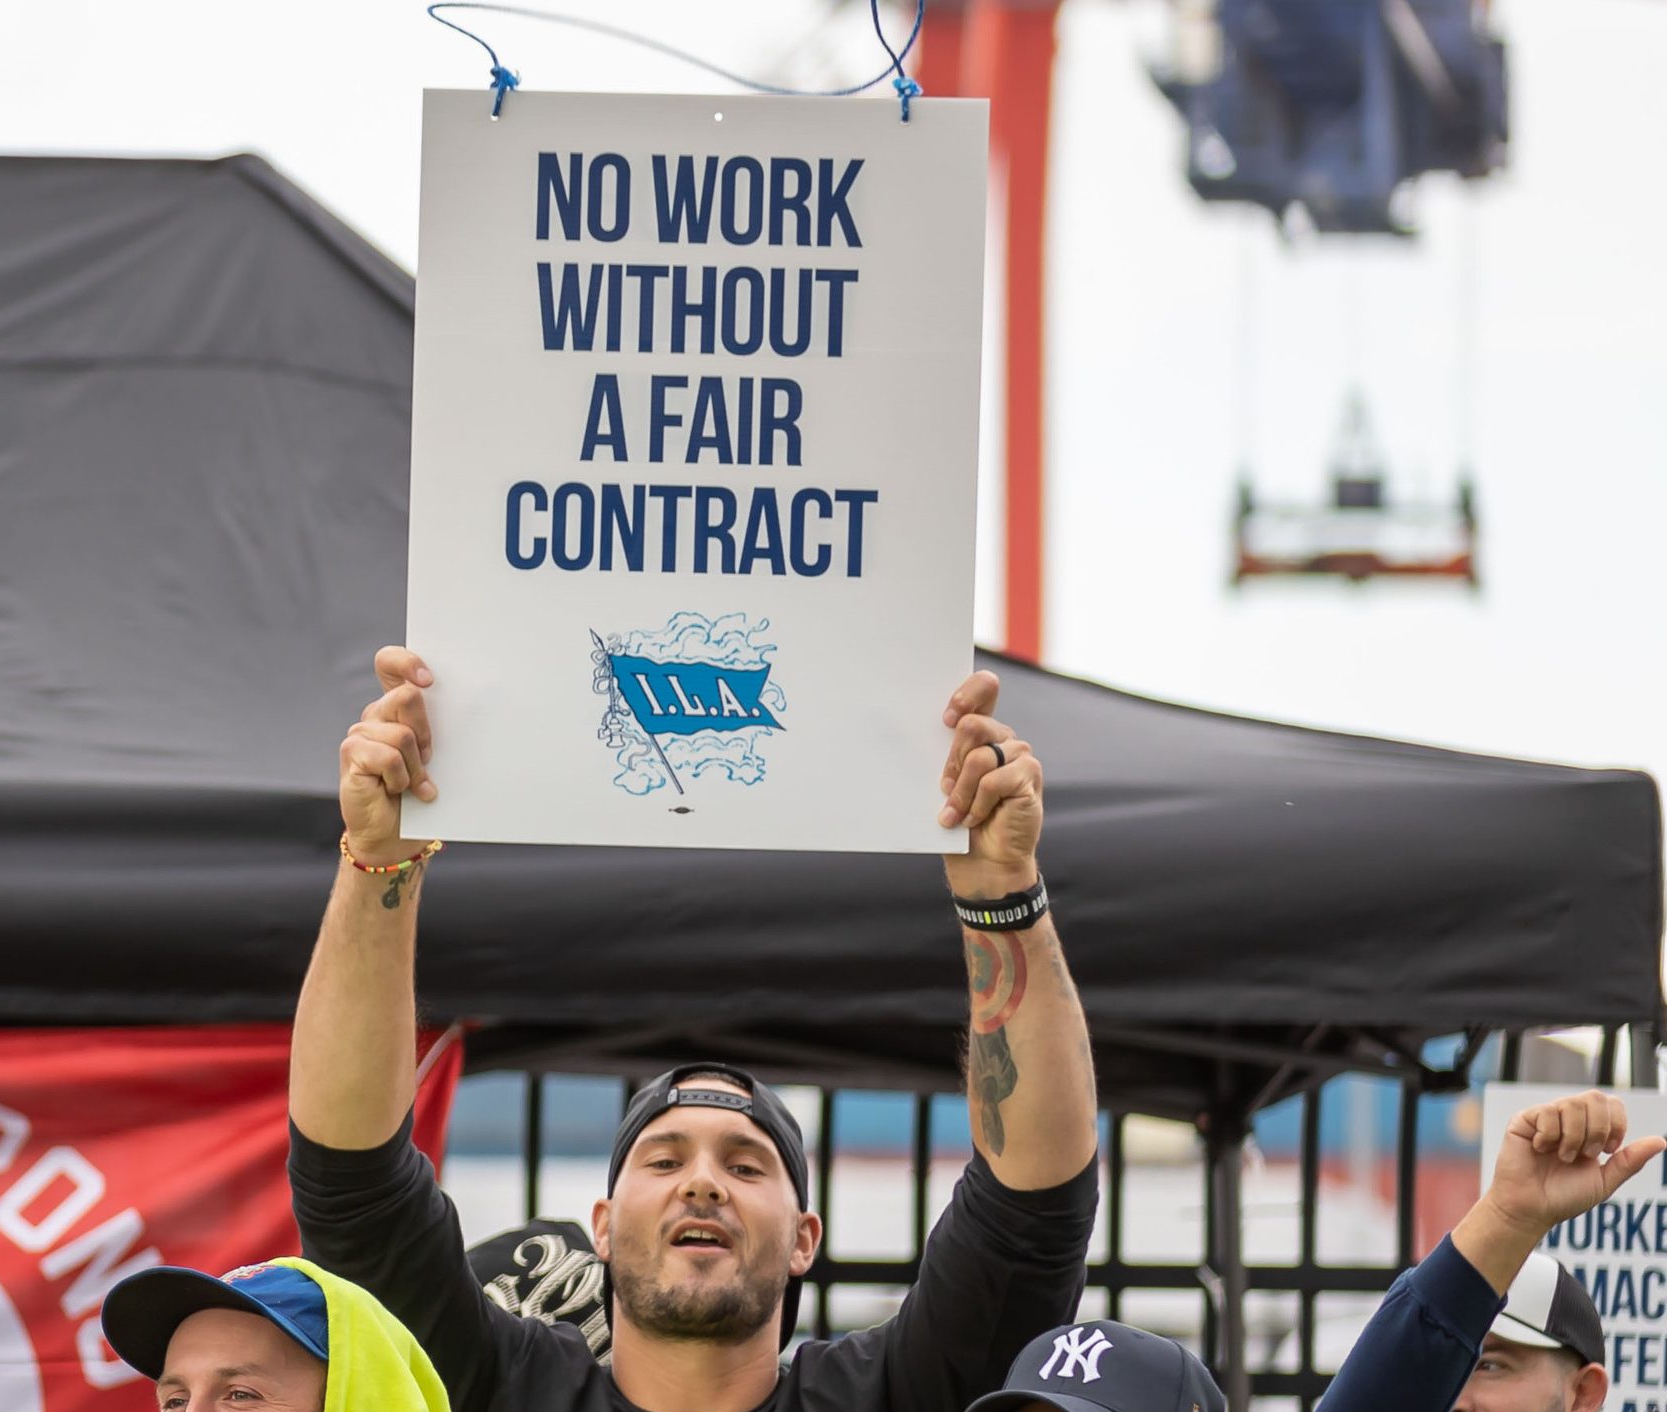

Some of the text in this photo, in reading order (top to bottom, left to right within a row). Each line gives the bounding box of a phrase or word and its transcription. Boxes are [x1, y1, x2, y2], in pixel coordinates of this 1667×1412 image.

[535, 151, 865, 249] NO WORK
[536, 262, 859, 358] WITHOUT
[579, 372, 803, 467] A FAIR
[505, 481, 878, 578] CONTRACT
[635, 672, 761, 719] I.L.A.
